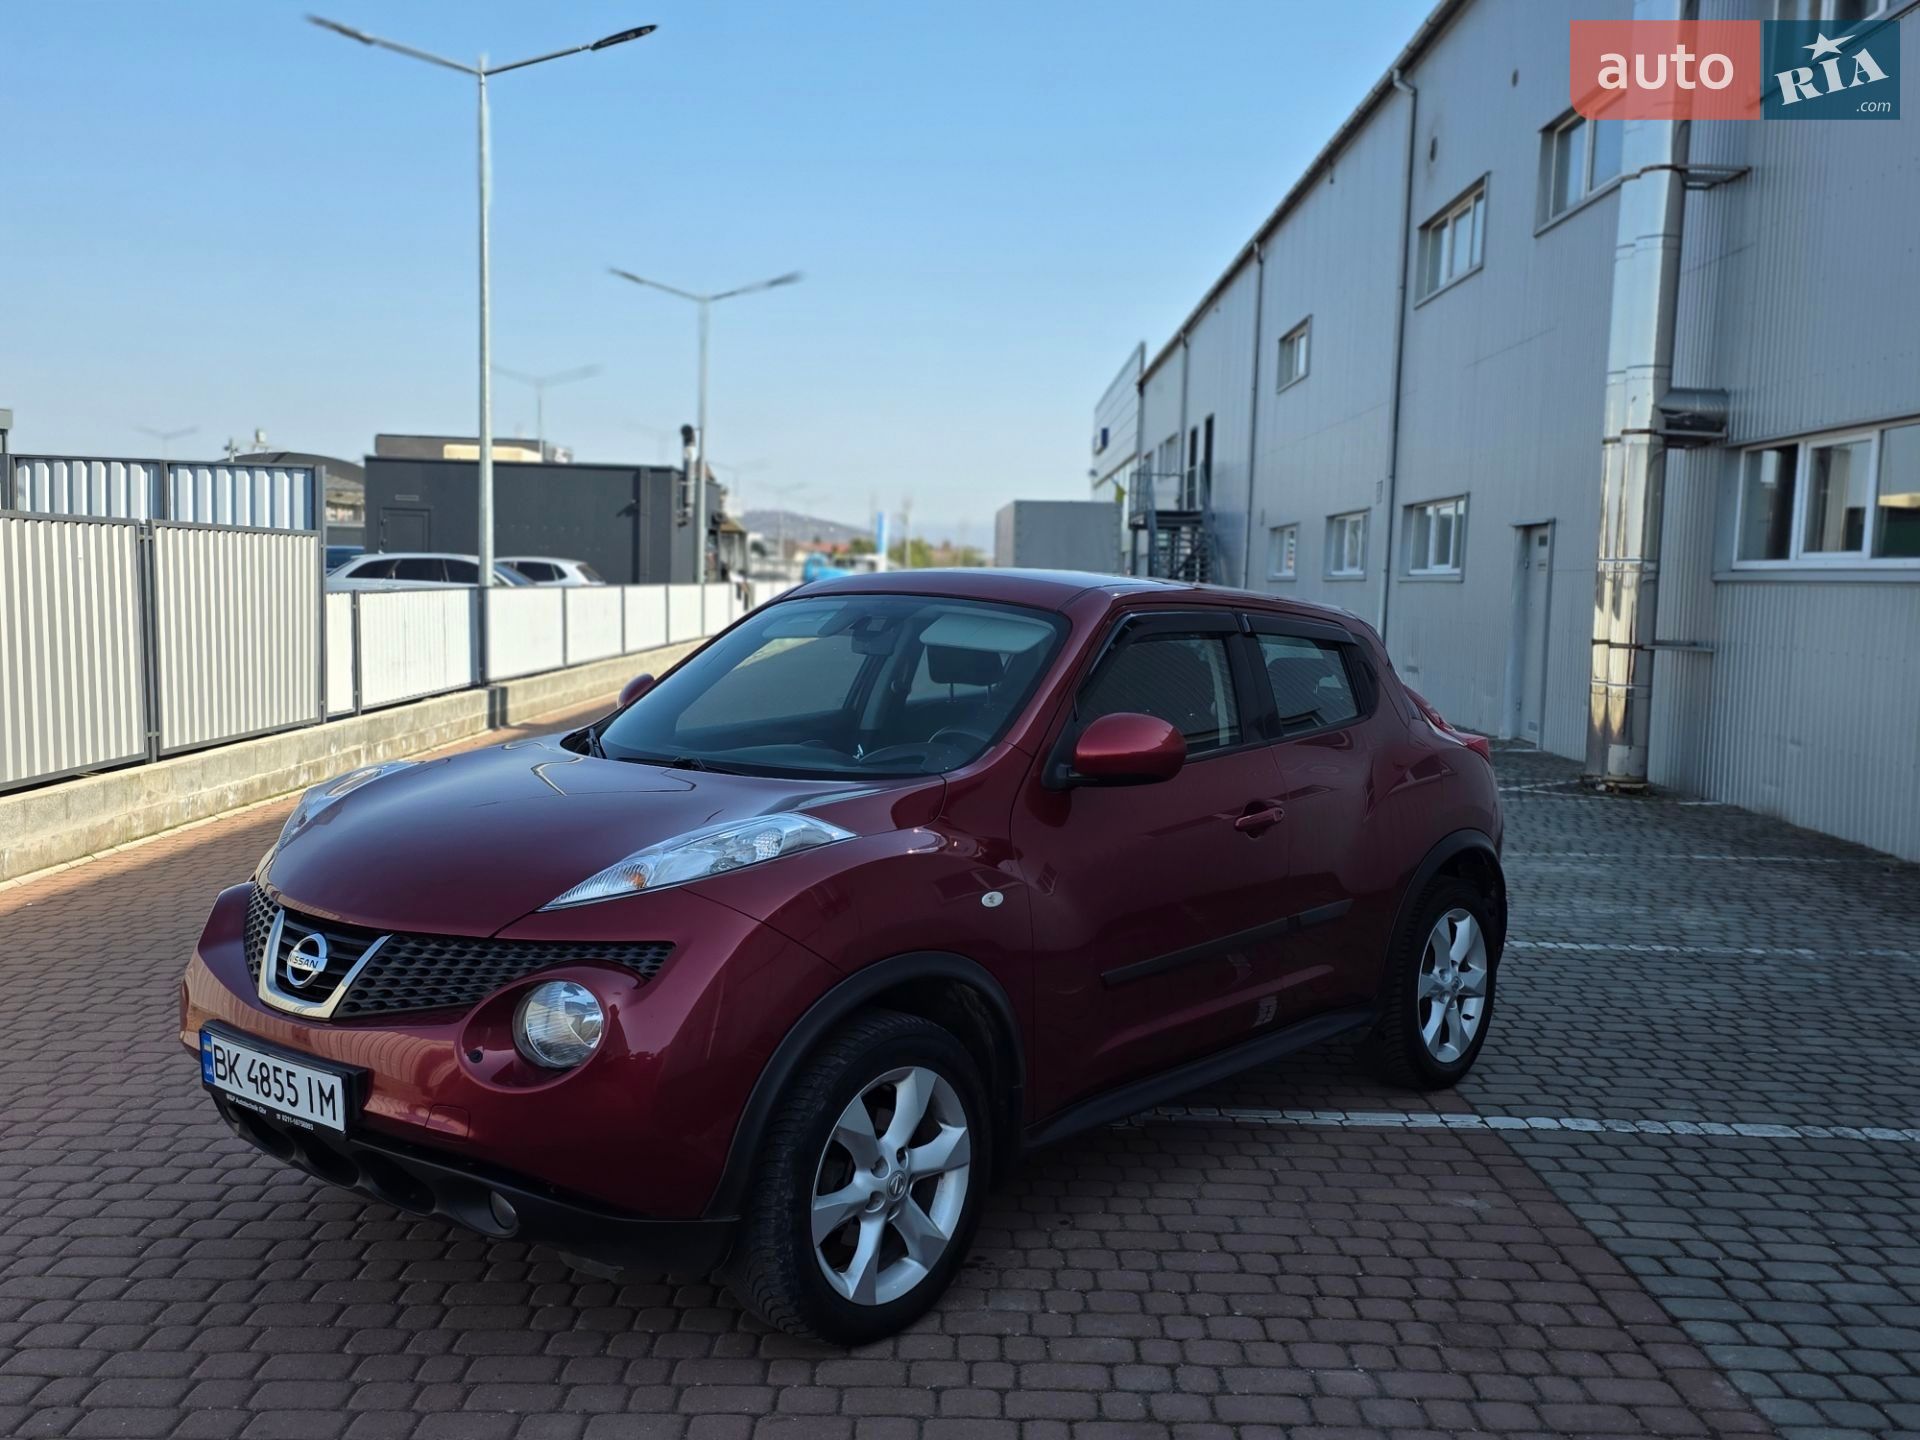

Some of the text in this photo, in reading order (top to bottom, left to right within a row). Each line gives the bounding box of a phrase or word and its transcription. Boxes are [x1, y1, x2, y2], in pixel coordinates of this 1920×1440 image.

[289, 952, 319, 969] SSAN
[213, 1044, 243, 1089] BK
[247, 1059, 298, 1108] 4855
[307, 1076, 337, 1121] IM
